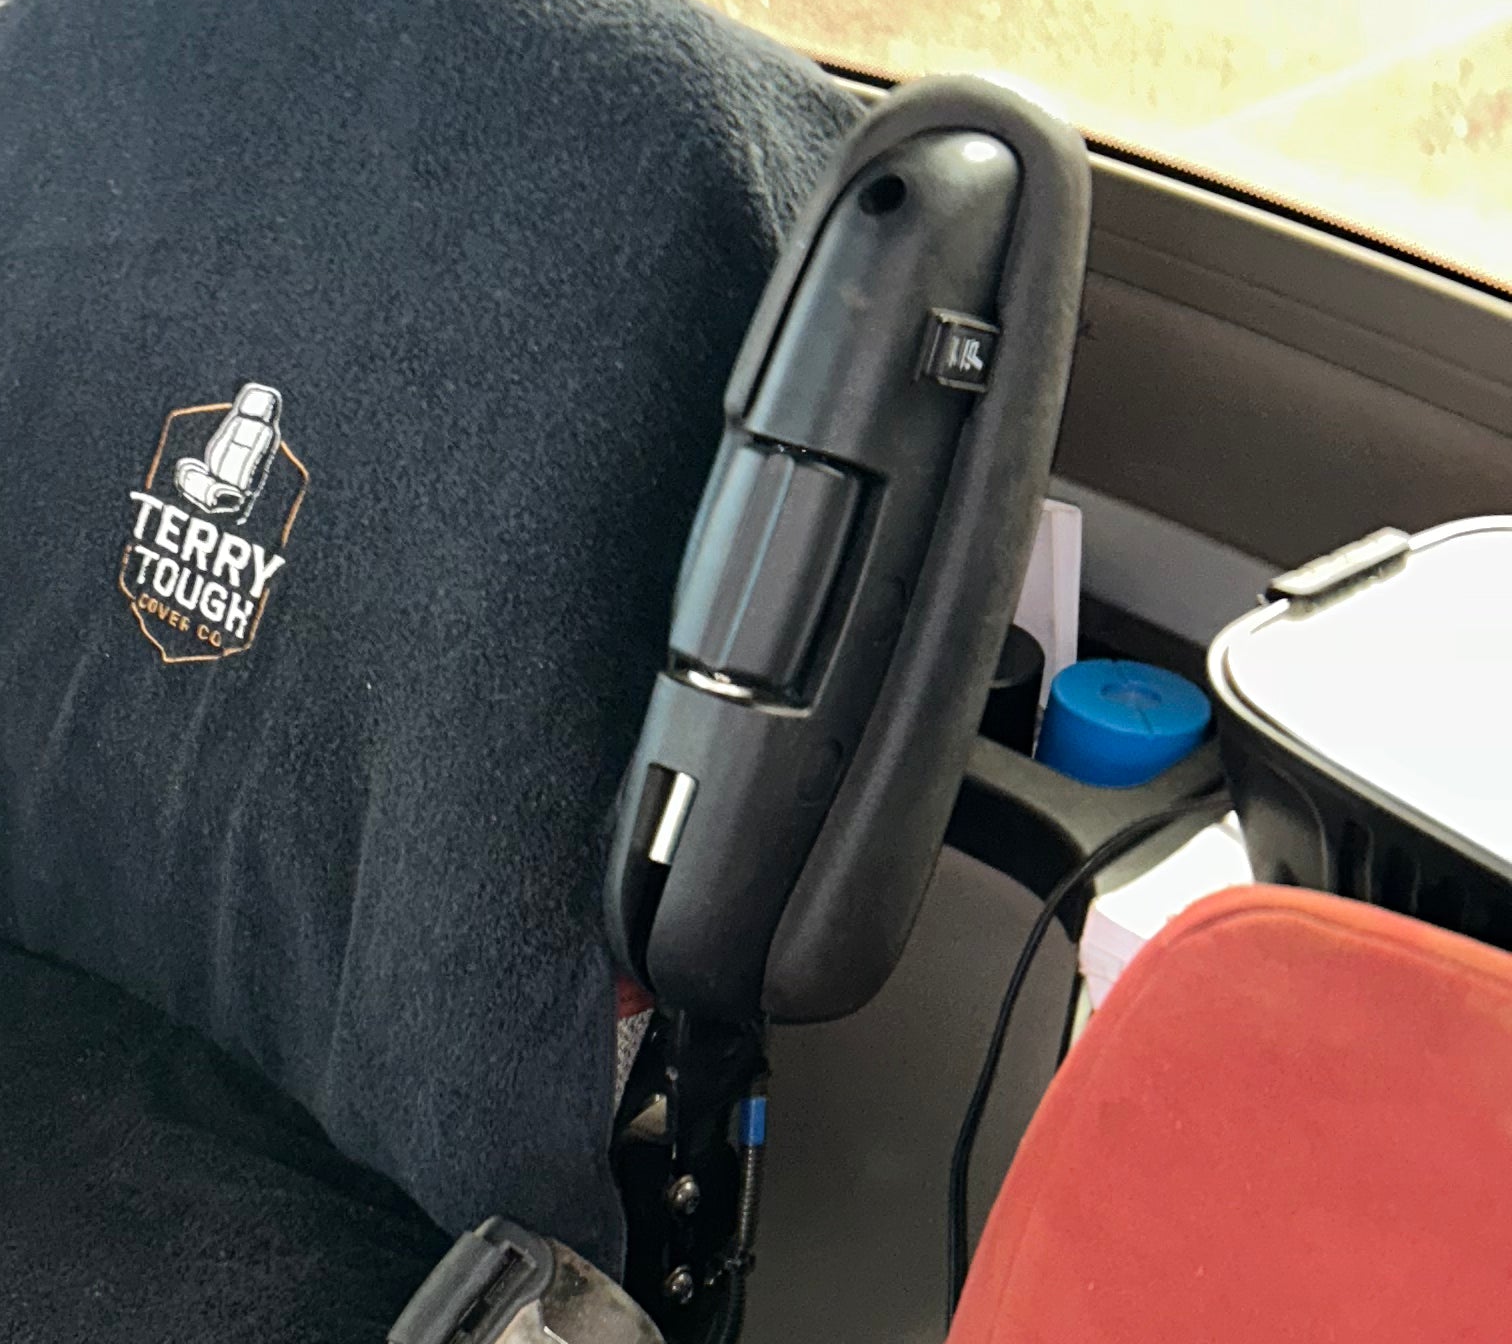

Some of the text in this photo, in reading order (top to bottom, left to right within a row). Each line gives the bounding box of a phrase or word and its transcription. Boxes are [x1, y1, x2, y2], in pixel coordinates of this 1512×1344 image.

[130, 491, 285, 598] TERRY
[135, 546, 254, 639] TOUGH
[138, 593, 222, 647] COVER CO
